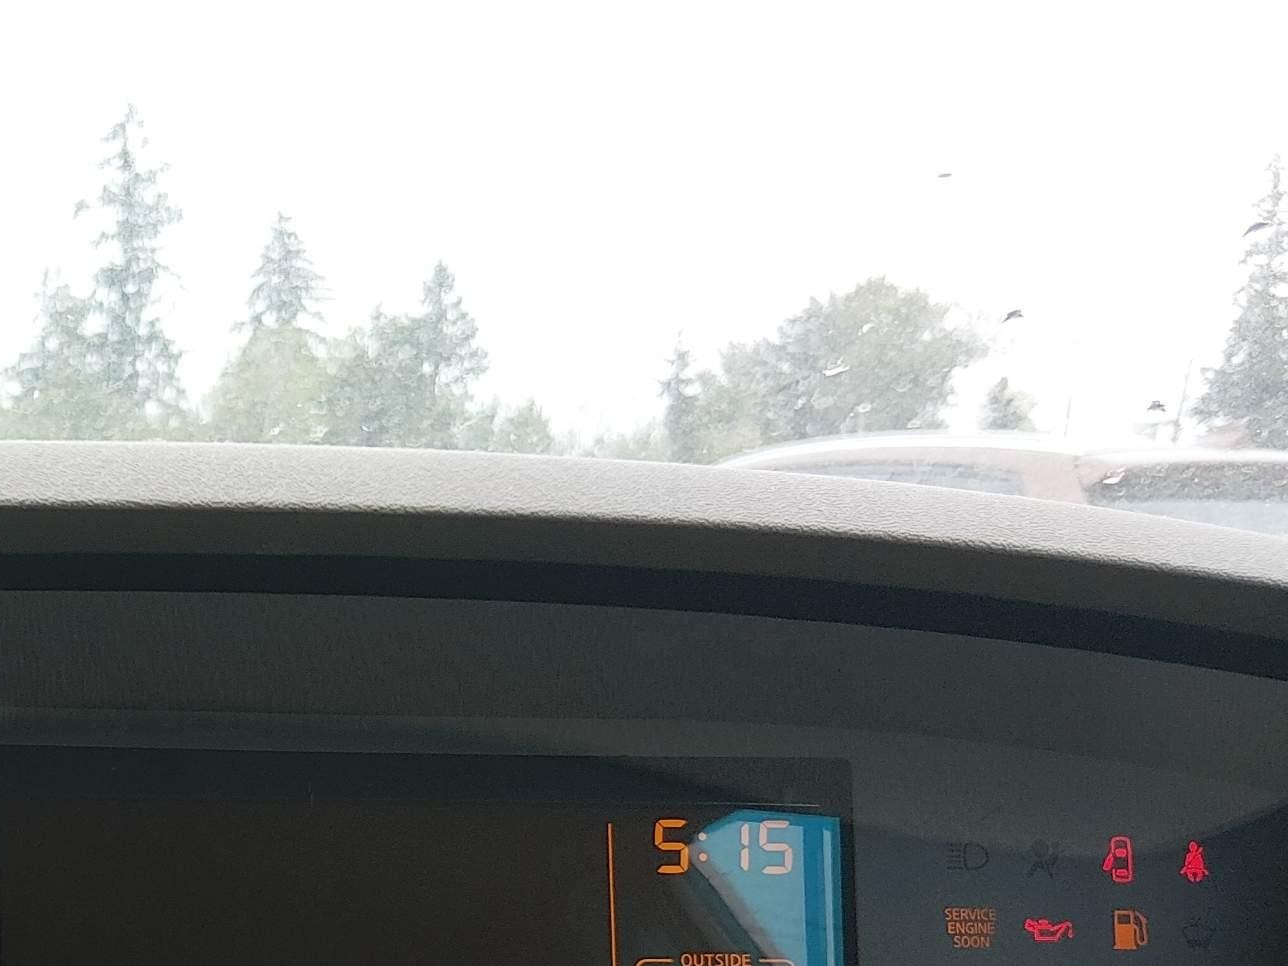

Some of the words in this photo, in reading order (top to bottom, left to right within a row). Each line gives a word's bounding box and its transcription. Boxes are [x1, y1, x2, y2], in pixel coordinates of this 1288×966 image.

[654, 819, 793, 875] 5:15
[944, 908, 997, 921] SERVICE
[947, 922, 996, 935] ENGINE
[953, 935, 990, 949] SOON
